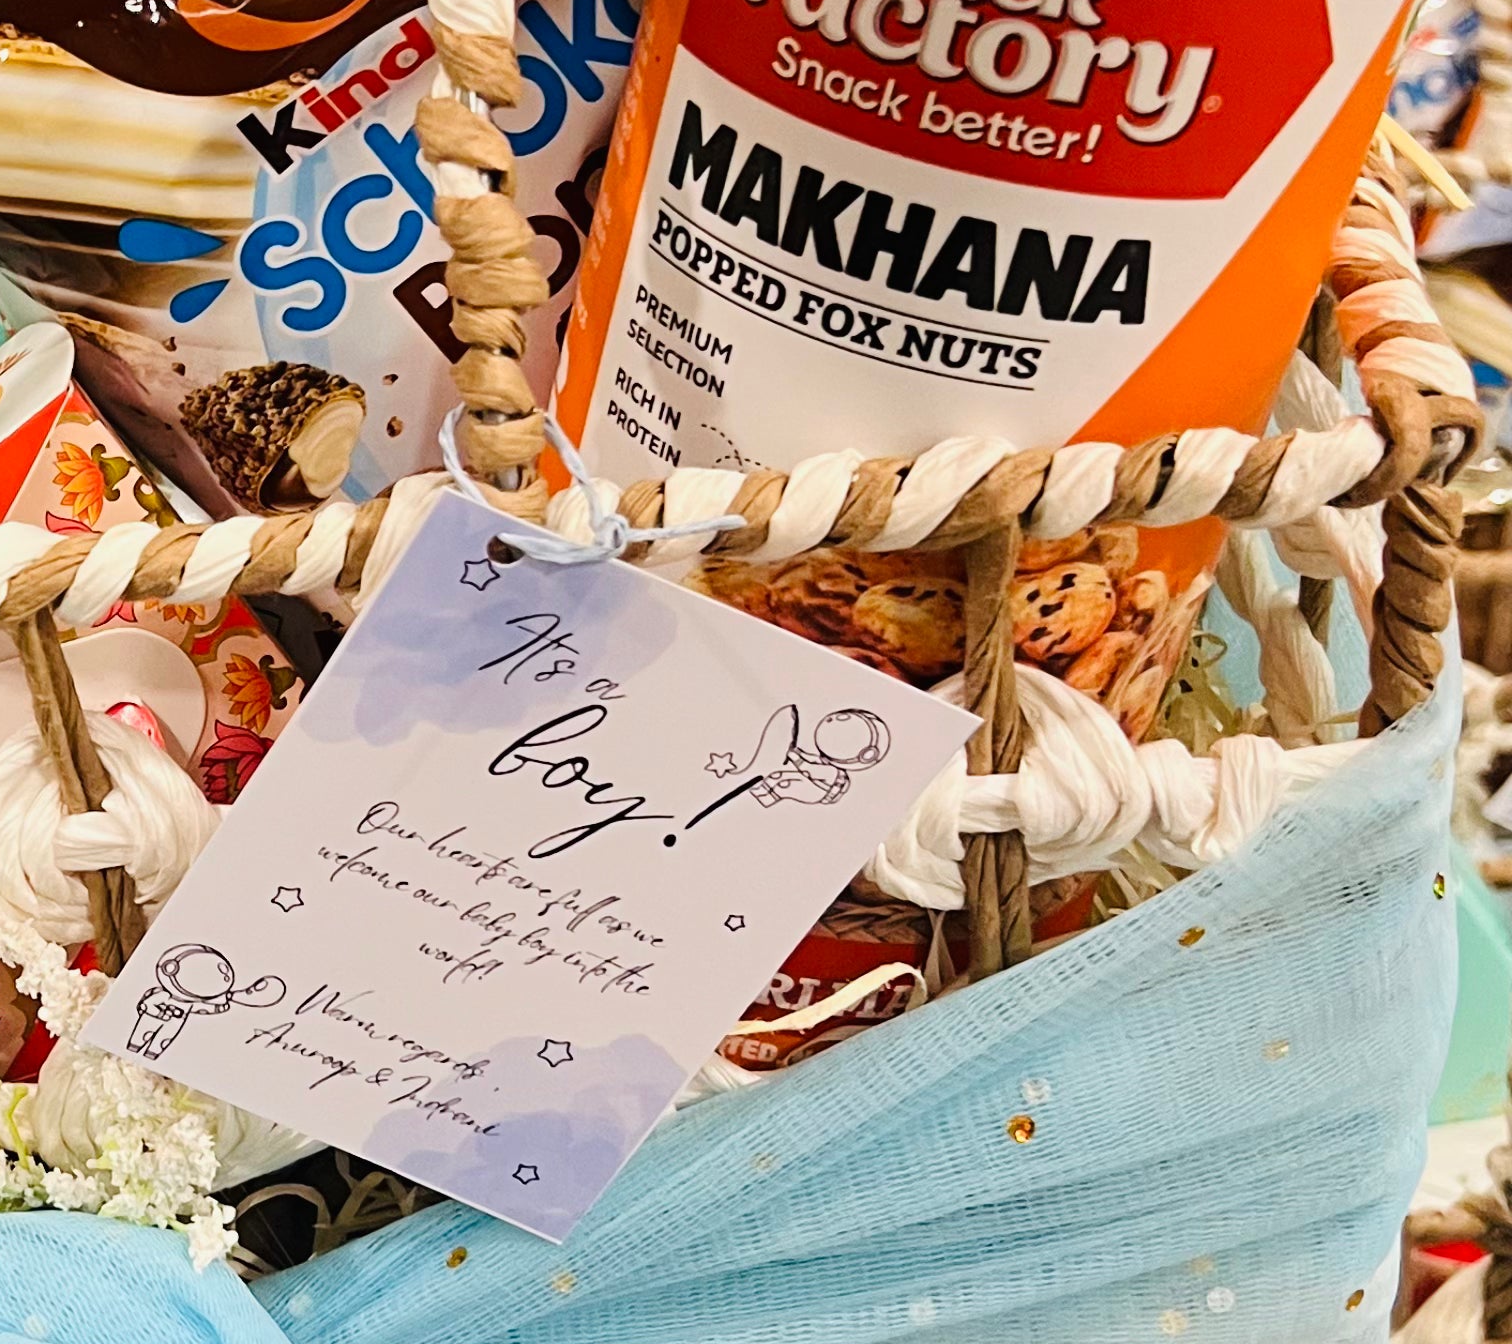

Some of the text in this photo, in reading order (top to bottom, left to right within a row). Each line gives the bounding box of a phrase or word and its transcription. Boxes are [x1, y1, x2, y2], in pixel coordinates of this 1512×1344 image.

[236, 17, 436, 175] Kind
[771, 37, 1103, 164] Snack better!
[667, 99, 1153, 325] MAKHANA
[635, 284, 734, 365] PREMIUM
[652, 208, 1043, 381] POPPED FOX NUTS
[614, 367, 682, 432] RICH IN
[626, 318, 726, 399] SELECTION
[607, 399, 682, 468] PROTEIN
[585, 678, 627, 701] a
[488, 703, 764, 859] boy!
[317, 846, 655, 997] welcome our baby boy into the
[356, 801, 666, 948] Our hearts are full as we
[294, 984, 388, 1040] Warm
[365, 1067, 394, 1087] &
